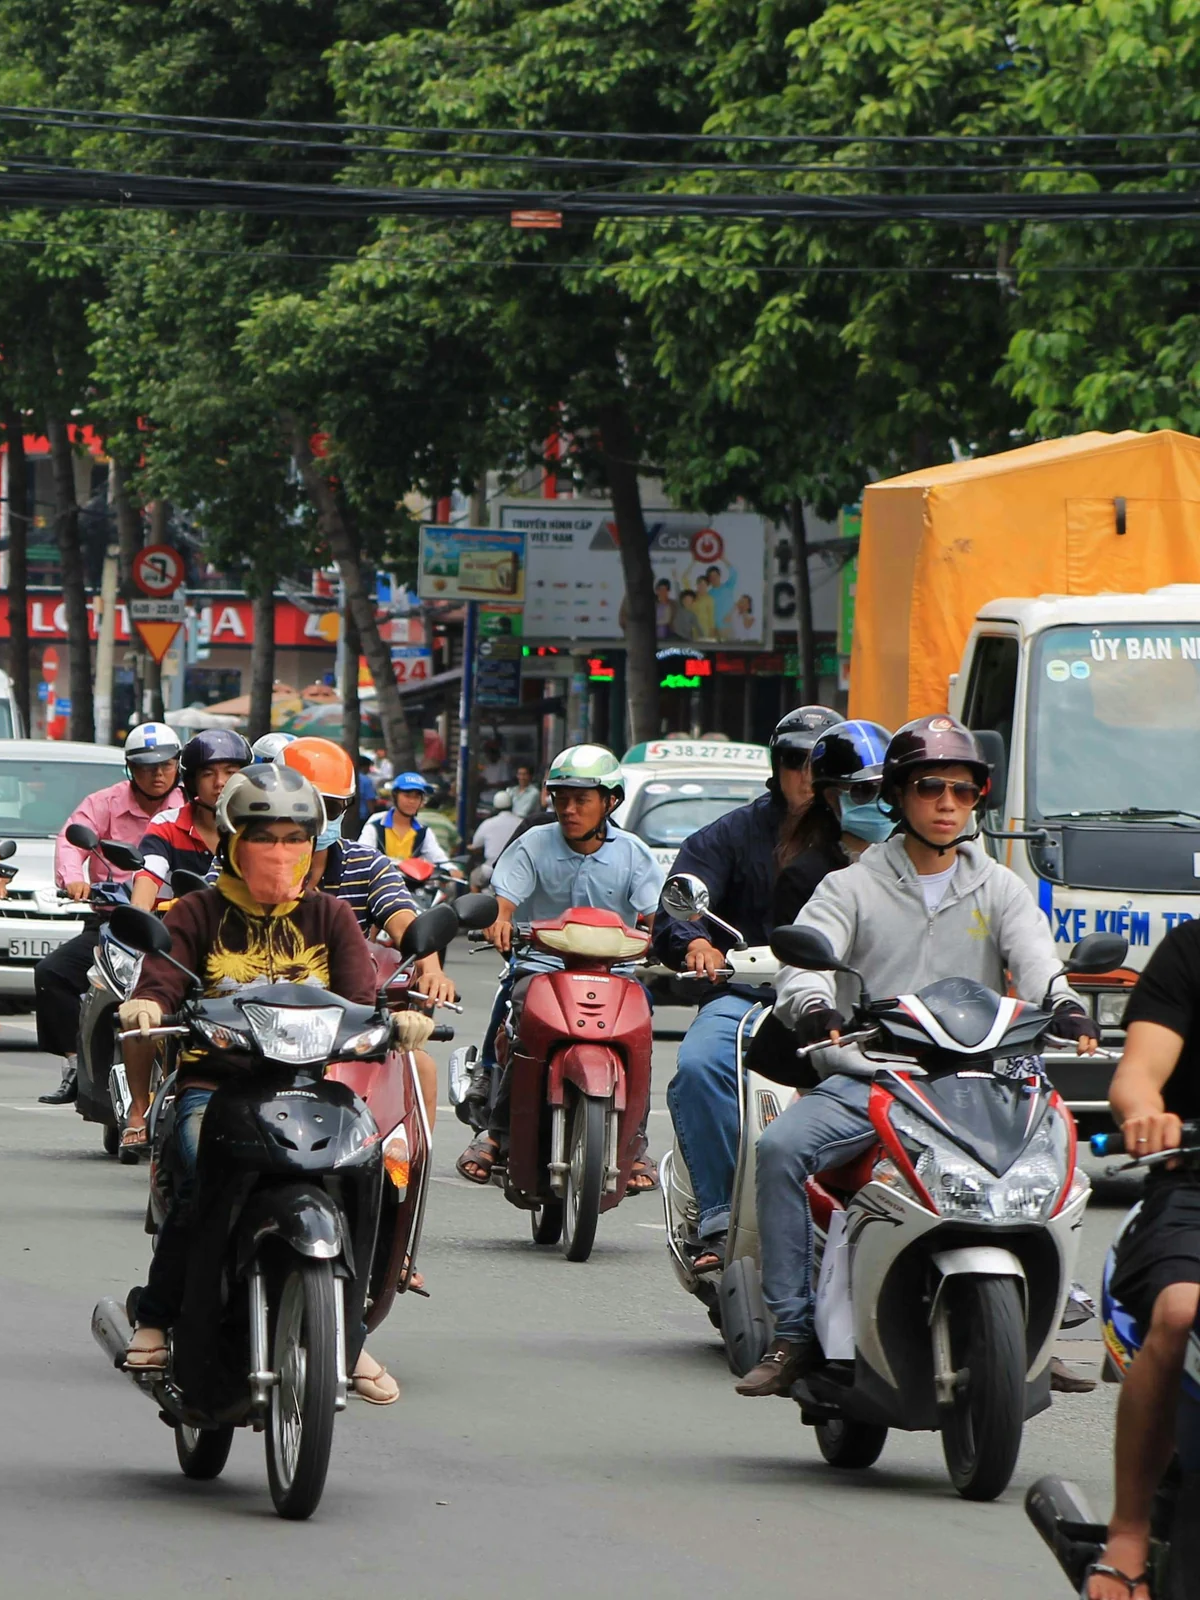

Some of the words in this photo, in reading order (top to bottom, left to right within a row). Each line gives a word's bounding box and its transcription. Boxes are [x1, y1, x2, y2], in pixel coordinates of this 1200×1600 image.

[1089, 629, 1121, 661] ỦY
[1125, 637, 1173, 661] BAN
[723, 746, 740, 759] 27
[746, 747, 763, 760] 27
[1054, 908, 1087, 944] XE
[1094, 900, 1150, 946] KIỂM
[275, 1090, 319, 1099] HONDA
